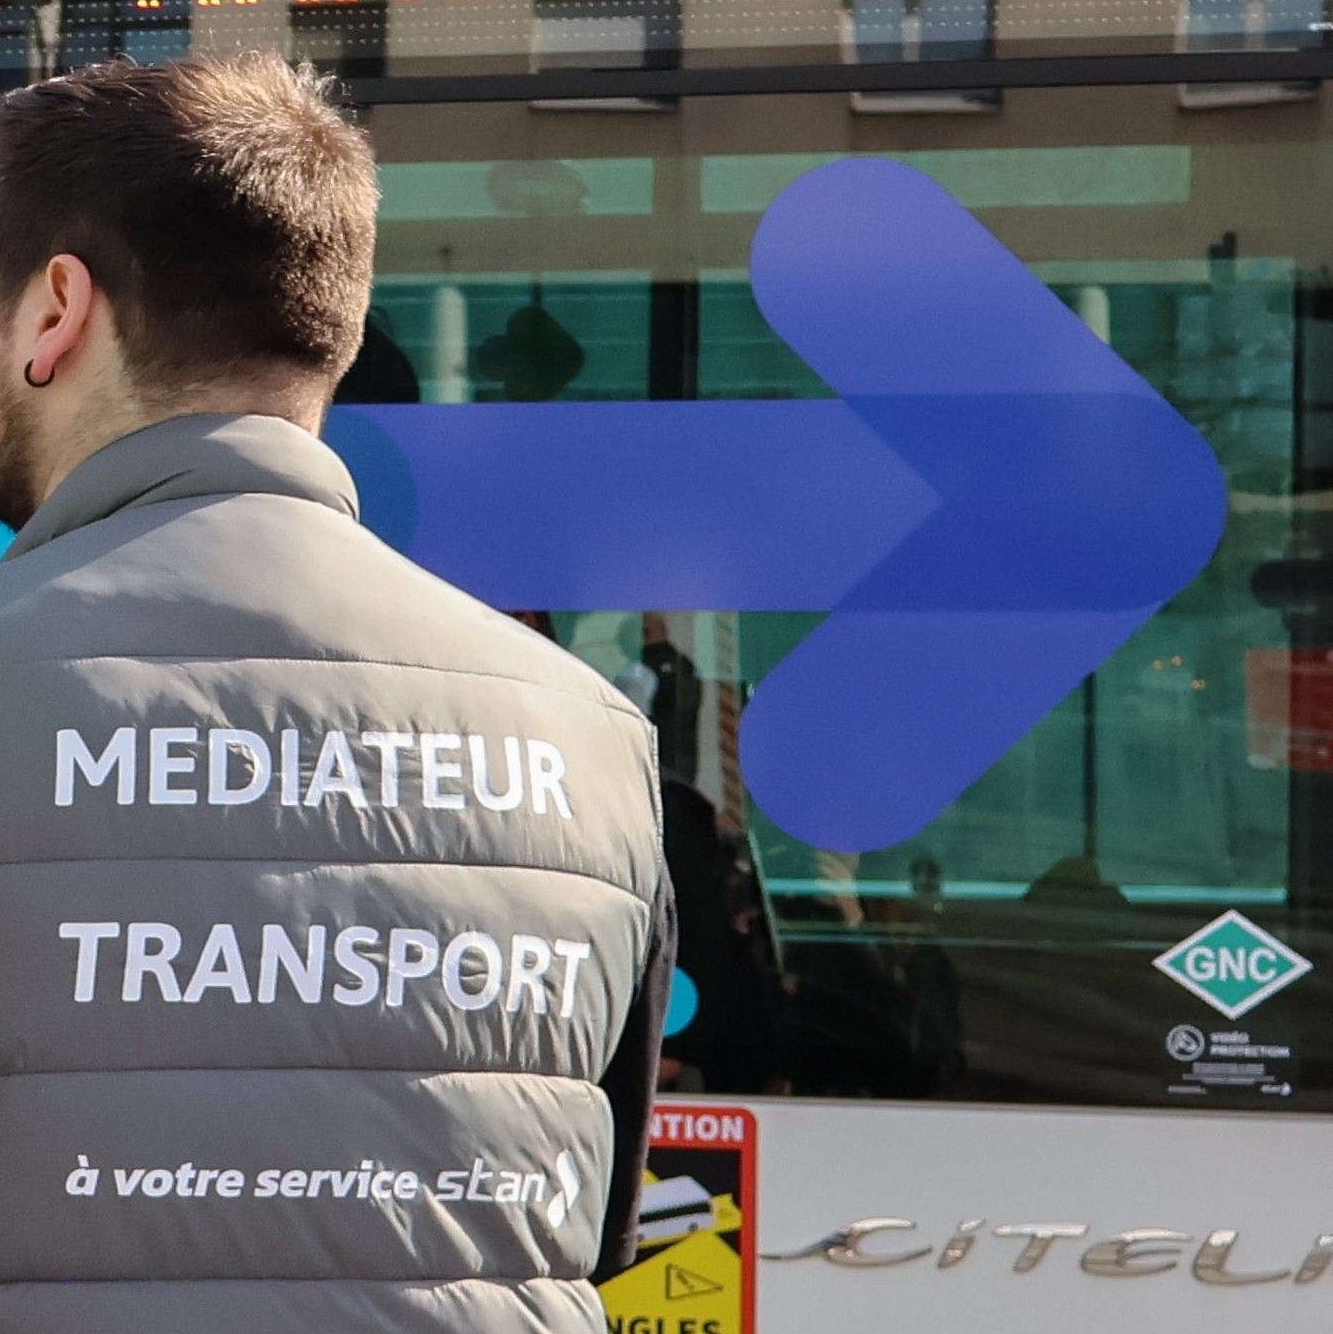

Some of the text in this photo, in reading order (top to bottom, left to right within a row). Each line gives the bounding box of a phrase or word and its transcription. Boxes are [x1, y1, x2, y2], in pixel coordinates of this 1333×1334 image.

[54, 726, 574, 820] MEDIATEUR
[59, 921, 591, 1018] TRANSPORT
[1185, 945, 1279, 984] GNC
[65, 1154, 545, 1203] à votre service stan
